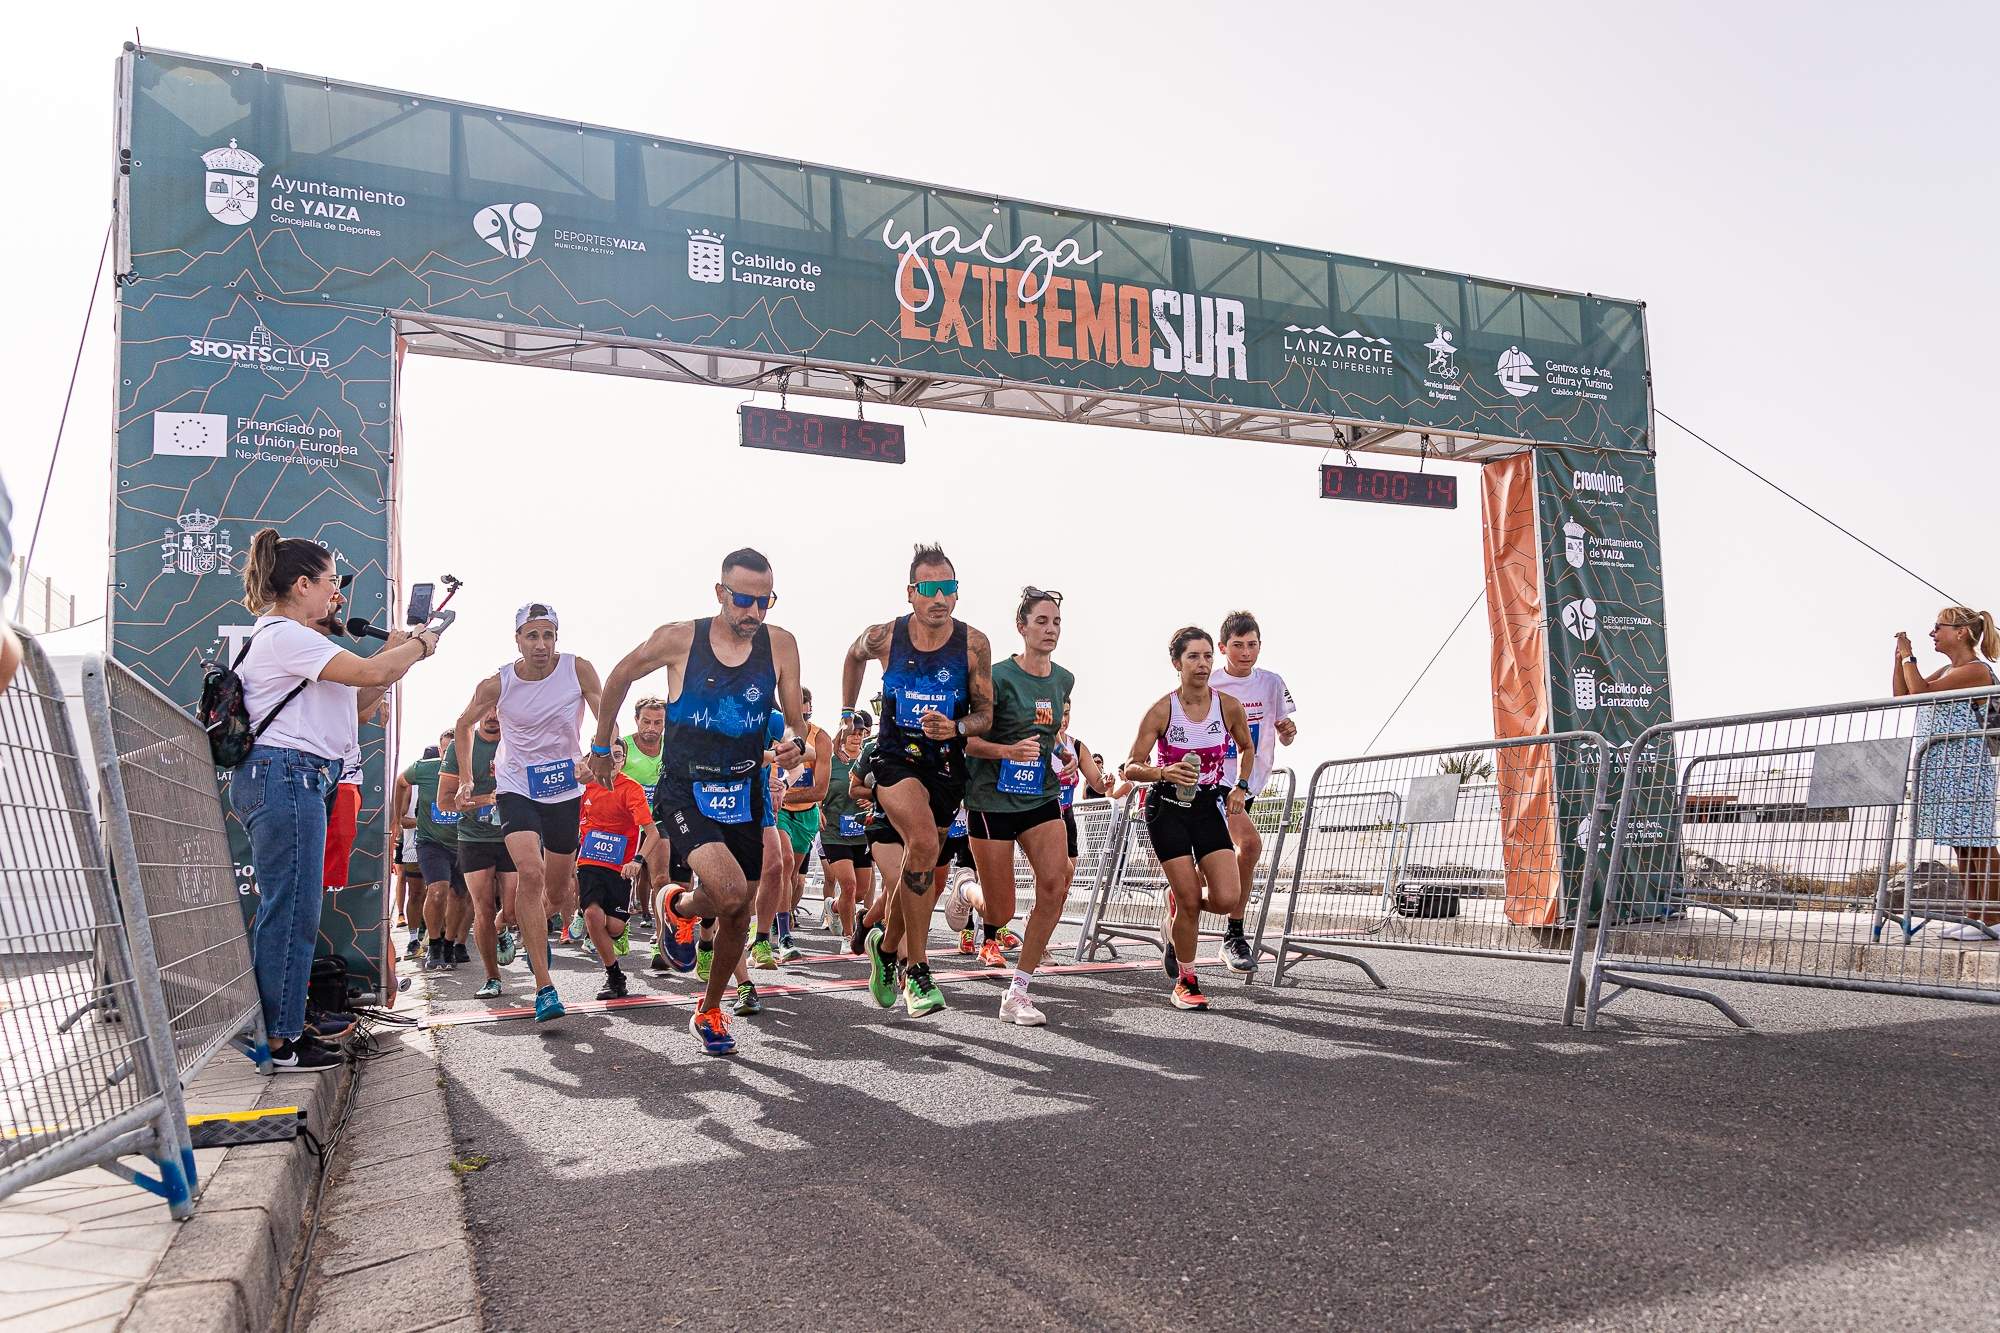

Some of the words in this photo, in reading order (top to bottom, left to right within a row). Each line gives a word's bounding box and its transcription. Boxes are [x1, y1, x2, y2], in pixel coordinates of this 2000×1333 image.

[271, 174, 406, 207] Ayuntamiento
[270, 195, 295, 213] de
[300, 199, 361, 222] YAIZA
[323, 222, 337, 231] de
[338, 223, 382, 237] Deportes
[554, 229, 647, 252] DEPORTESYAIZA
[554, 242, 589, 252] MUNICIPIO
[590, 247, 615, 256] ACTIVO
[731, 250, 797, 273] Cabildo
[800, 261, 822, 277] de
[882, 218, 1103, 312] yaiza
[732, 267, 816, 292] Lanzarote
[898, 253, 1248, 381] EXTREMOSUR
[189, 339, 330, 368] SPORTSCLUB
[1283, 335, 1394, 364] LANZAROTE
[234, 361, 259, 370] Puerto
[1284, 353, 1299, 364] LA
[1302, 356, 1328, 368] ISLA
[1332, 360, 1394, 376] DIFERENTE
[1545, 360, 1579, 374] Centros
[1580, 365, 1591, 376] de
[1593, 366, 1613, 379] Arte,
[1546, 372, 1577, 387] Cultura
[1576, 379, 1583, 389] y
[1582, 377, 1614, 391] Turismo
[1551, 387, 1574, 396] Cabildo
[1582, 390, 1608, 401] Lanzarote
[236, 417, 315, 436] Financiado
[318, 426, 343, 439] por
[235, 432, 250, 445] la
[254, 434, 295, 449] Unión
[300, 438, 359, 456] Europea
[235, 449, 340, 469] NextGenerationEU
[1588, 535, 1644, 549] Ayuntamiento
[1589, 547, 1600, 559] de
[1600, 549, 1625, 561] YAIZA
[1602, 615, 1652, 626] DEPORTESYAIZA
[1599, 681, 1638, 694] Cabildo
[1639, 683, 1653, 695] de
[1599, 695, 1650, 707] Lanzarote
[542, 771, 565, 785] 455
[1014, 769, 1034, 782] 456
[709, 796, 736, 810] 443
[593, 841, 614, 853] 403
